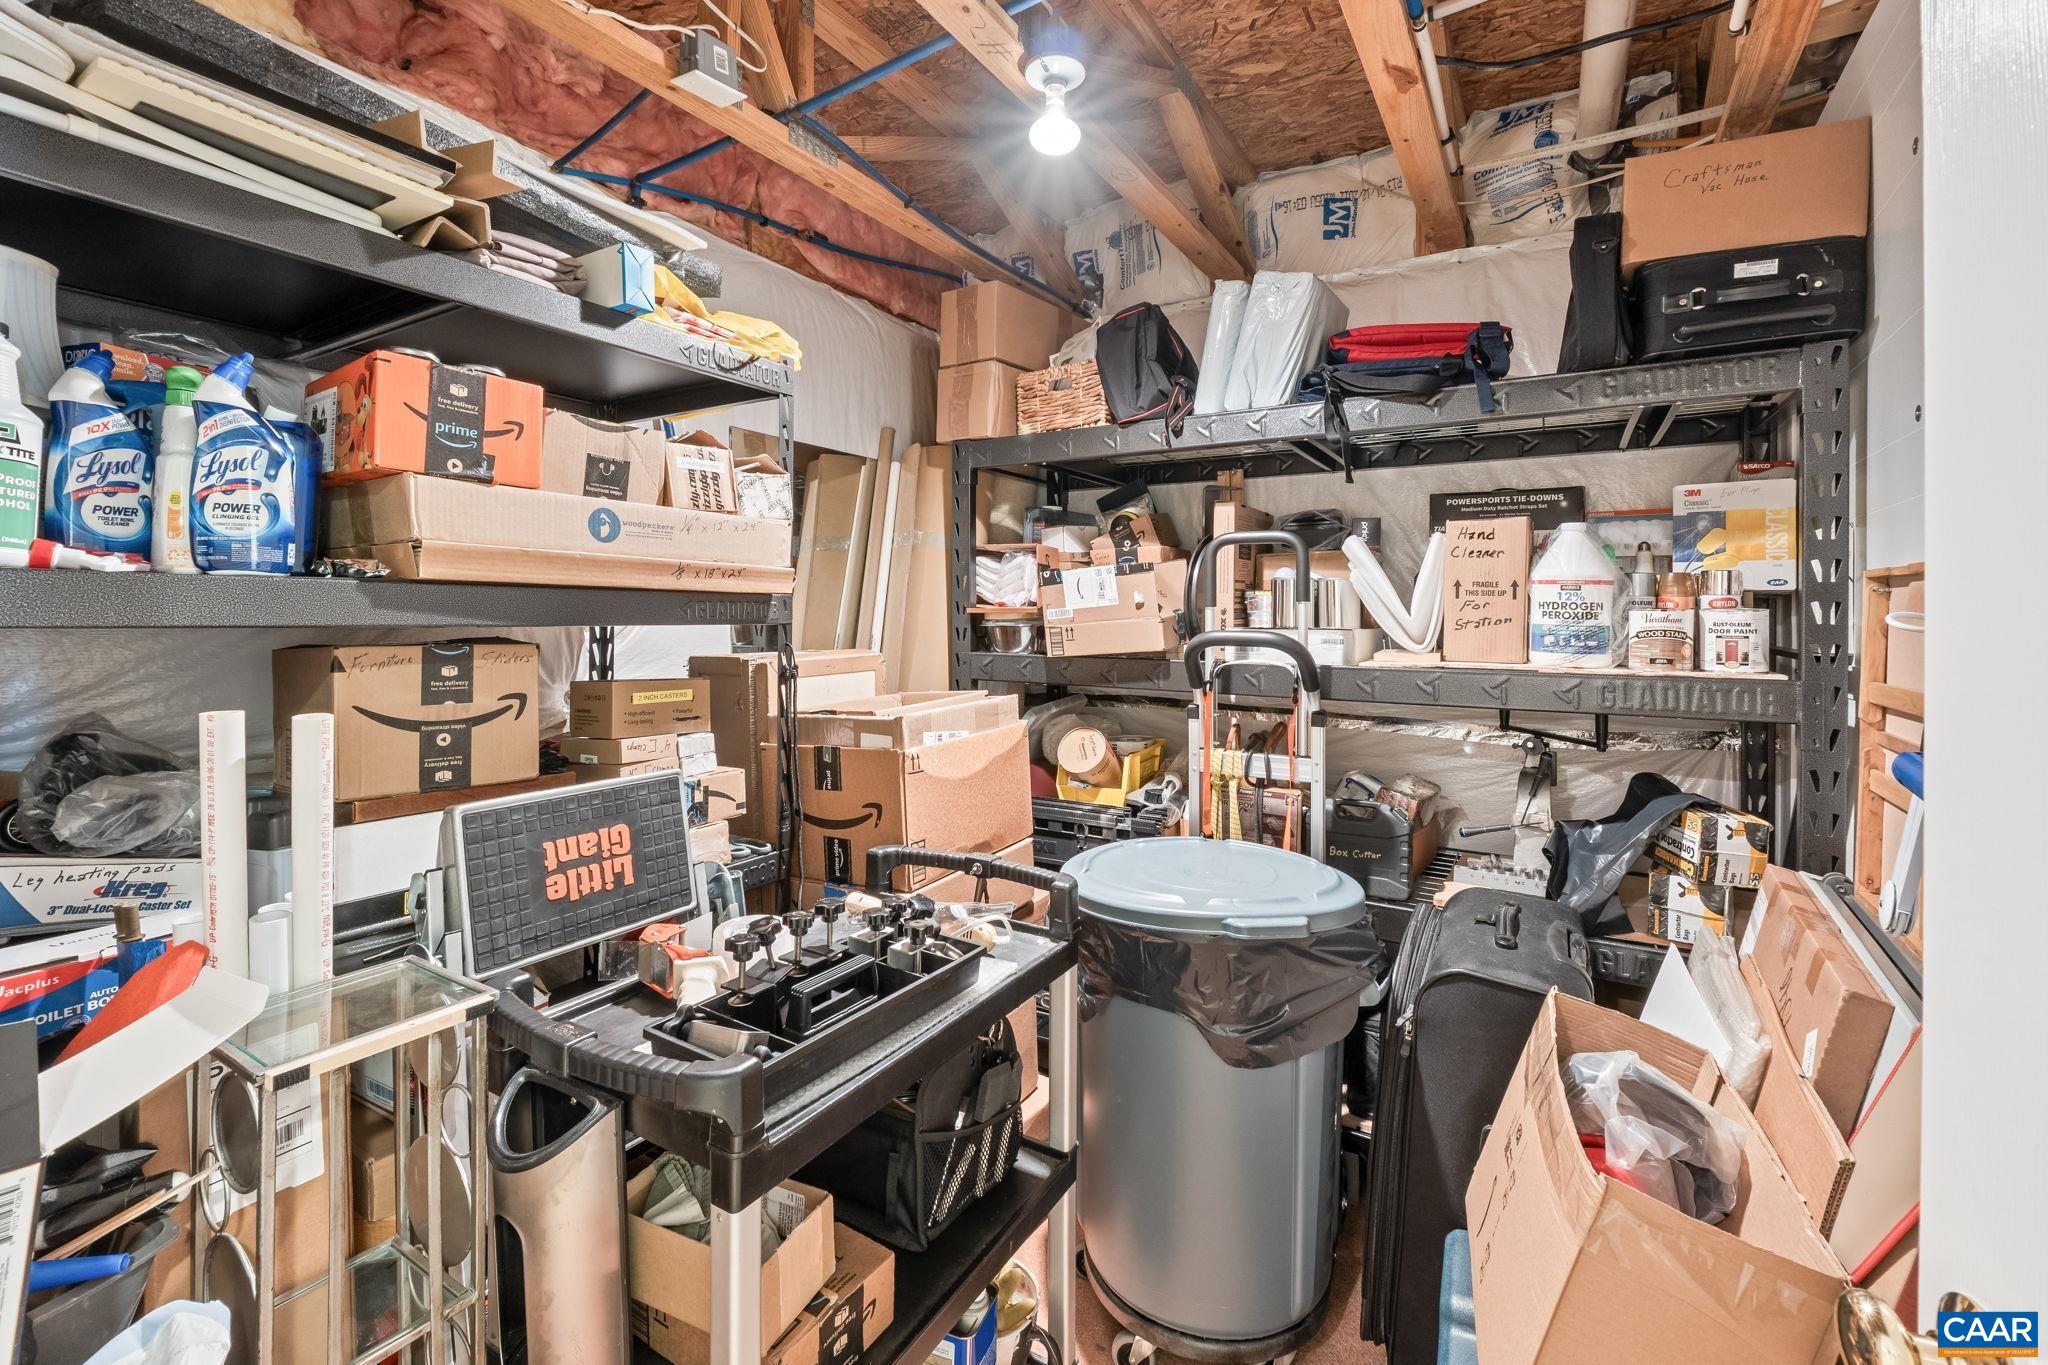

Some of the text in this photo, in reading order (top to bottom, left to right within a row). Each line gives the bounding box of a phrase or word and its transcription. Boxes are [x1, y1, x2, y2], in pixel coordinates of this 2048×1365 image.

[1664, 159, 1762, 189] Craftsman
[1699, 173, 1769, 194] Vac Hose
[1323, 200, 1353, 240] JM
[697, 347, 781, 388] GLADIATOR
[437, 397, 479, 412] free delivery
[86, 420, 111, 436] 10X
[202, 420, 219, 438] 2in1
[435, 421, 478, 439] prime
[76, 452, 140, 485] Lysol
[200, 449, 262, 484] Lysol
[1446, 493, 1564, 506] POWERSPORTS TIE-DOWNS
[1684, 489, 1701, 497] 3M
[92, 504, 139, 517] POWER
[212, 502, 261, 514] POWER
[622, 520, 674, 530] woodpeckers
[1457, 527, 1496, 541] Hand
[1450, 546, 1505, 560] Cleaner
[1556, 592, 1585, 602] 12%
[1712, 599, 1736, 608] KRYLON
[1459, 600, 1491, 613] For
[1538, 601, 1604, 612] HYDROGEN
[1541, 610, 1600, 621] PEROXIDE
[1454, 617, 1513, 631] Station
[1637, 630, 1688, 640] WOOD STAIN
[476, 650, 534, 669] Sliders
[660, 692, 688, 700] CASTERS
[542, 823, 632, 873] Giant
[1660, 832, 1696, 859] Contractor
[1329, 846, 1382, 860] Box Cutter
[13, 863, 176, 892] Leg heating pads
[545, 854, 636, 901] Little
[1749, 872, 1760, 886] 55
[100, 880, 168, 899] Kreg
[175, 900, 192, 910] Set
[89, 985, 119, 1000] AUTO
[34, 1002, 85, 1026] OILET
